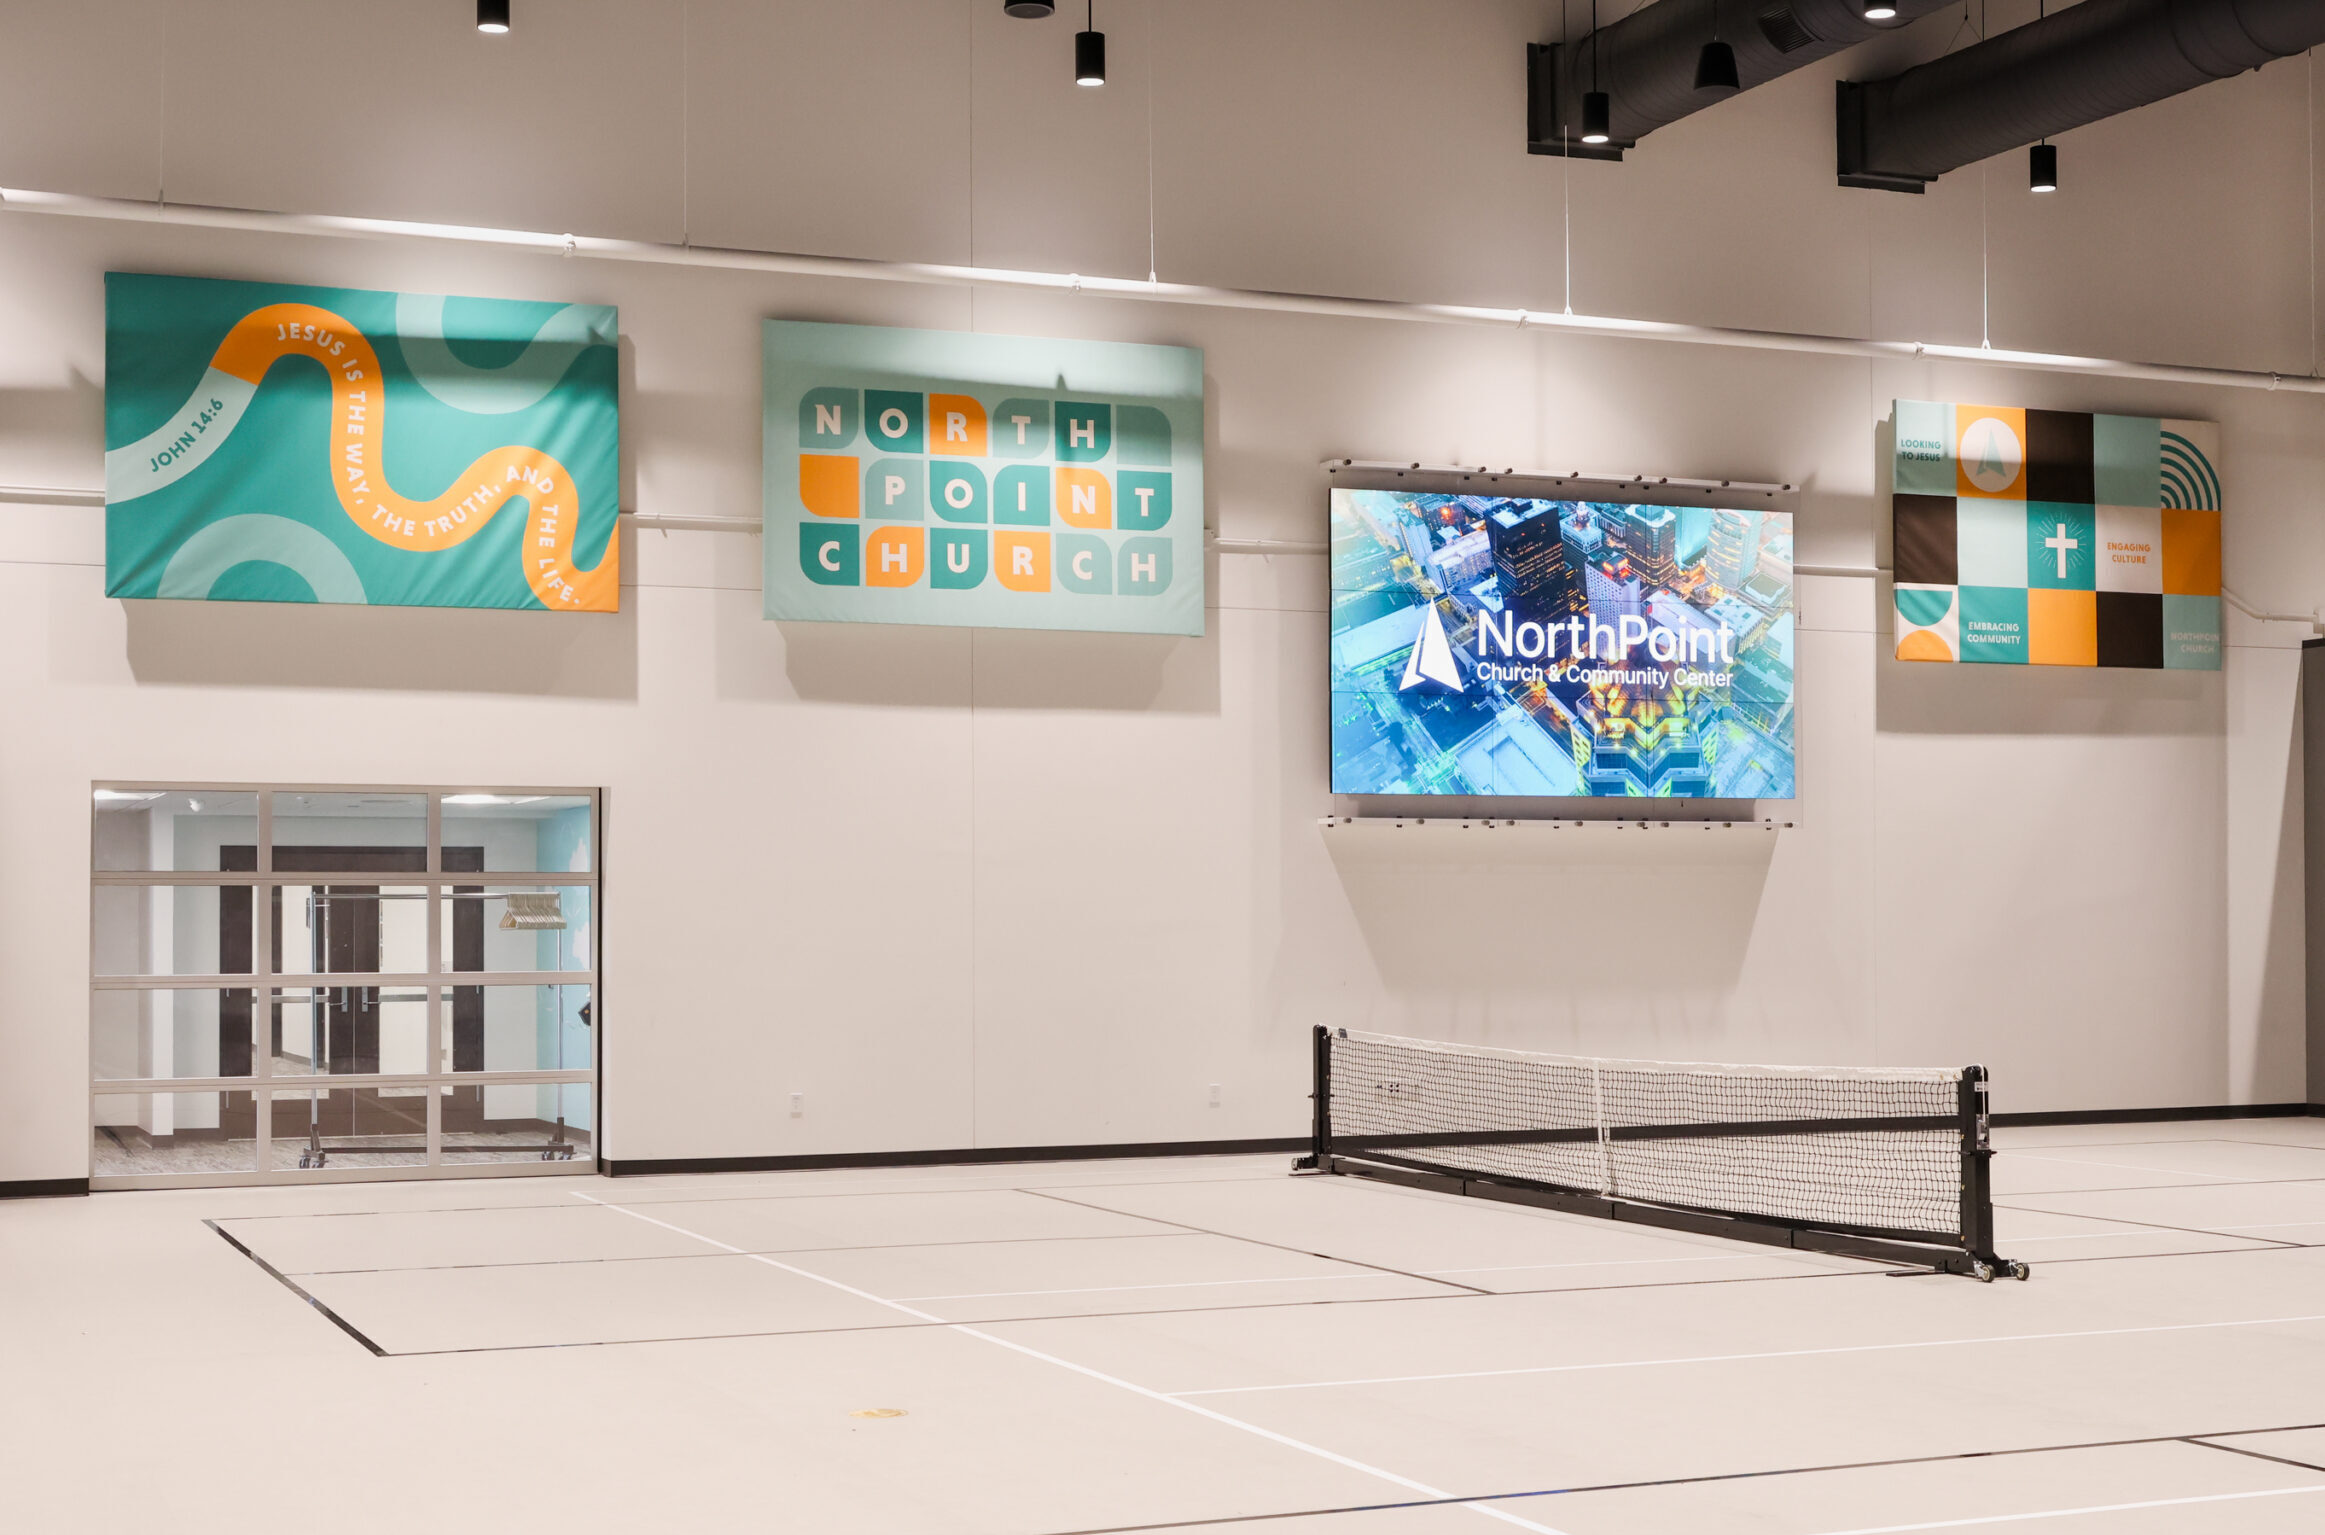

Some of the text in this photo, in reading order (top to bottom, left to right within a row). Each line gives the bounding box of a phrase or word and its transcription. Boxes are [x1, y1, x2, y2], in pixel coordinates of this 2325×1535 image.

[150, 398, 223, 472] JOHN 14:6
[814, 404, 1095, 449] NORTH
[1901, 439, 1941, 449] LOOKING
[278, 323, 580, 604] JESUS IS THE WAY, THE TRUTH, AND THE LIFE.
[1901, 451, 1941, 462] TO JESUS
[884, 475, 1155, 517] POINT
[2107, 542, 2151, 552] ENGAGING
[818, 540, 1156, 582] CHURCH
[2112, 554, 2147, 564] CULTURE
[1968, 621, 2020, 632] EMBRACING
[1477, 609, 1734, 663] NorthPoint
[1967, 634, 2021, 645] COMMUNITY
[2180, 644, 2215, 654] CHURCH
[1476, 662, 1734, 688] Church & Community Center
